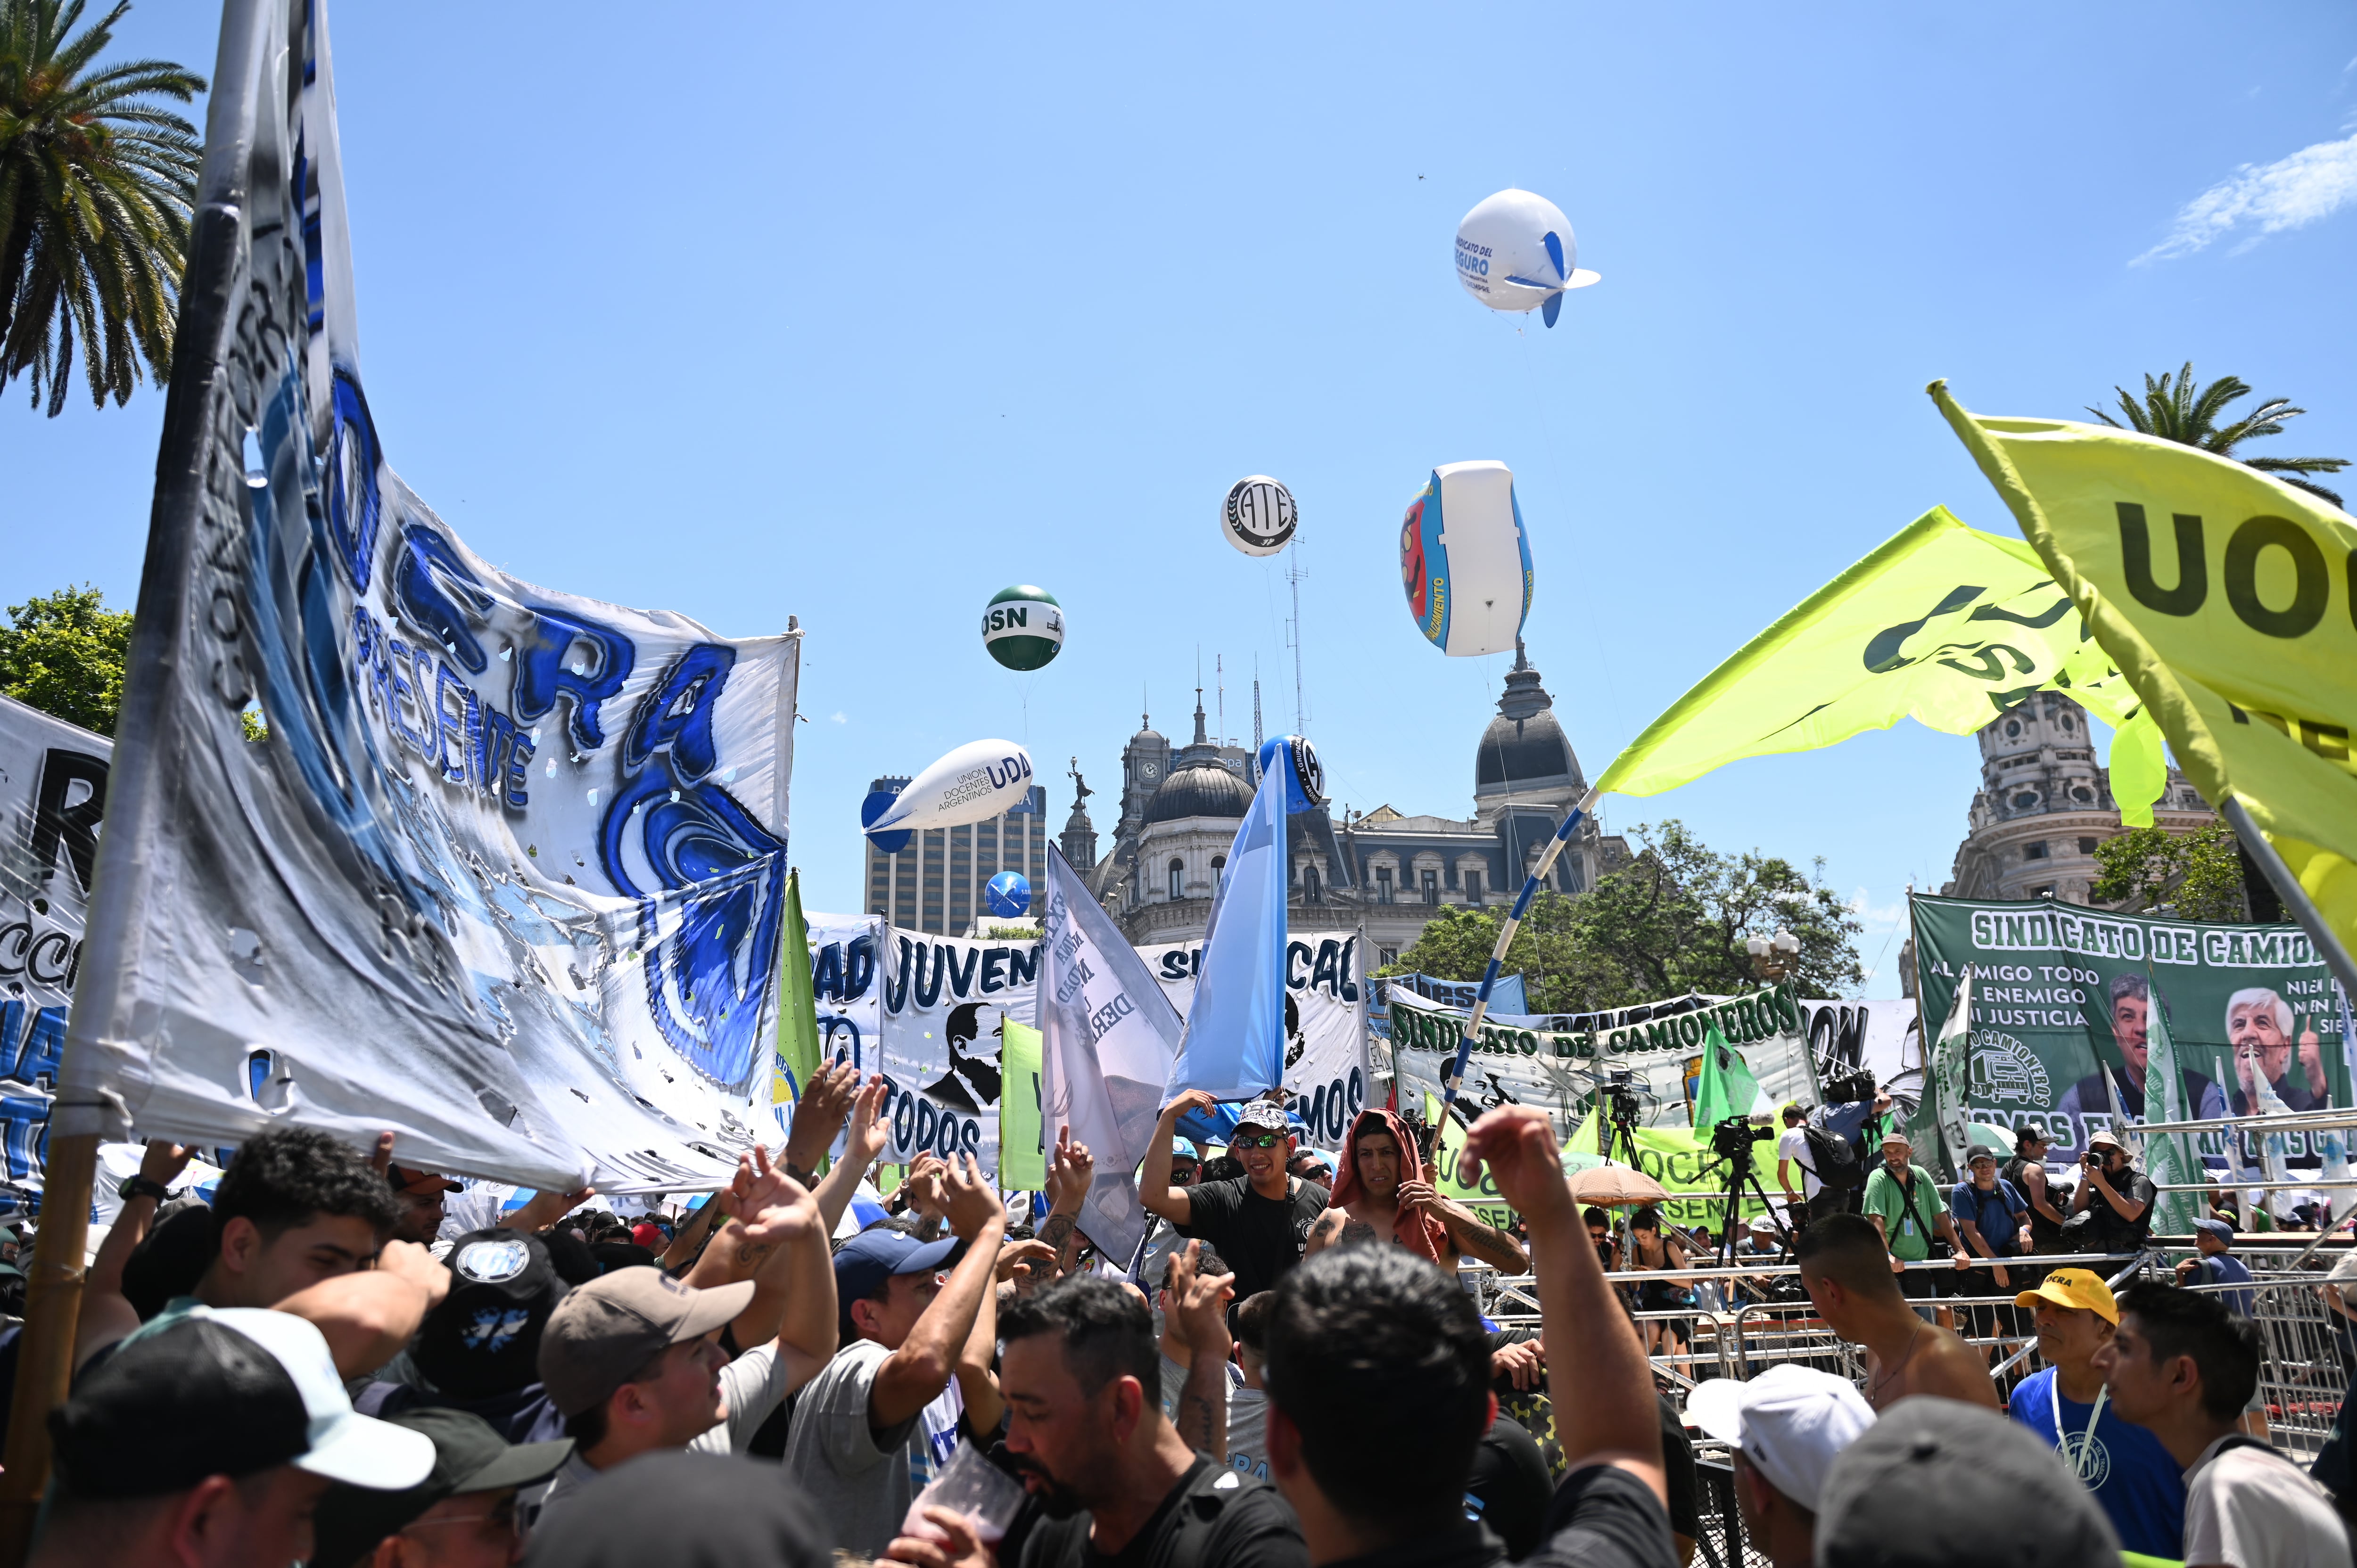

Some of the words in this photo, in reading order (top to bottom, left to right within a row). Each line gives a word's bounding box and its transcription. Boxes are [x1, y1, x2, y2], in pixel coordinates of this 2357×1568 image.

[1455, 248, 1489, 276] EGURO
[1479, 246, 1492, 257] DEL
[1466, 280, 1491, 293] SIEMPRE
[1241, 483, 1287, 530] ATE
[2115, 501, 2357, 639] UO
[982, 607, 1027, 636] OSN
[957, 768, 986, 784] UNION
[986, 752, 1031, 789] UDA
[939, 786, 992, 813] ARGENTINOS
[944, 776, 989, 800] DOCENTES
[1305, 785, 1319, 803] ANDRES
[1972, 911, 2143, 958] SINDICATO
[2151, 927, 2198, 967] DE
[886, 936, 1045, 1014] JUVEN
[1930, 961, 1954, 977] AL
[1959, 964, 2032, 982] AMIGO
[2038, 966, 2100, 985] TODO
[1983, 986, 2086, 1004] ENEMIGO
[1553, 1036, 1596, 1058] DE
[1608, 988, 1797, 1054] CAMIONEROS
[1988, 1008, 2090, 1026] JUSTICIA
[1981, 1029, 2051, 1108] CAMIONEROS
[881, 1074, 980, 1161] TODOS
[1285, 1066, 1363, 1145] MOS
[2045, 1276, 2072, 1287] OCRA
[2096, 1458, 2105, 1481] TRABAJO
